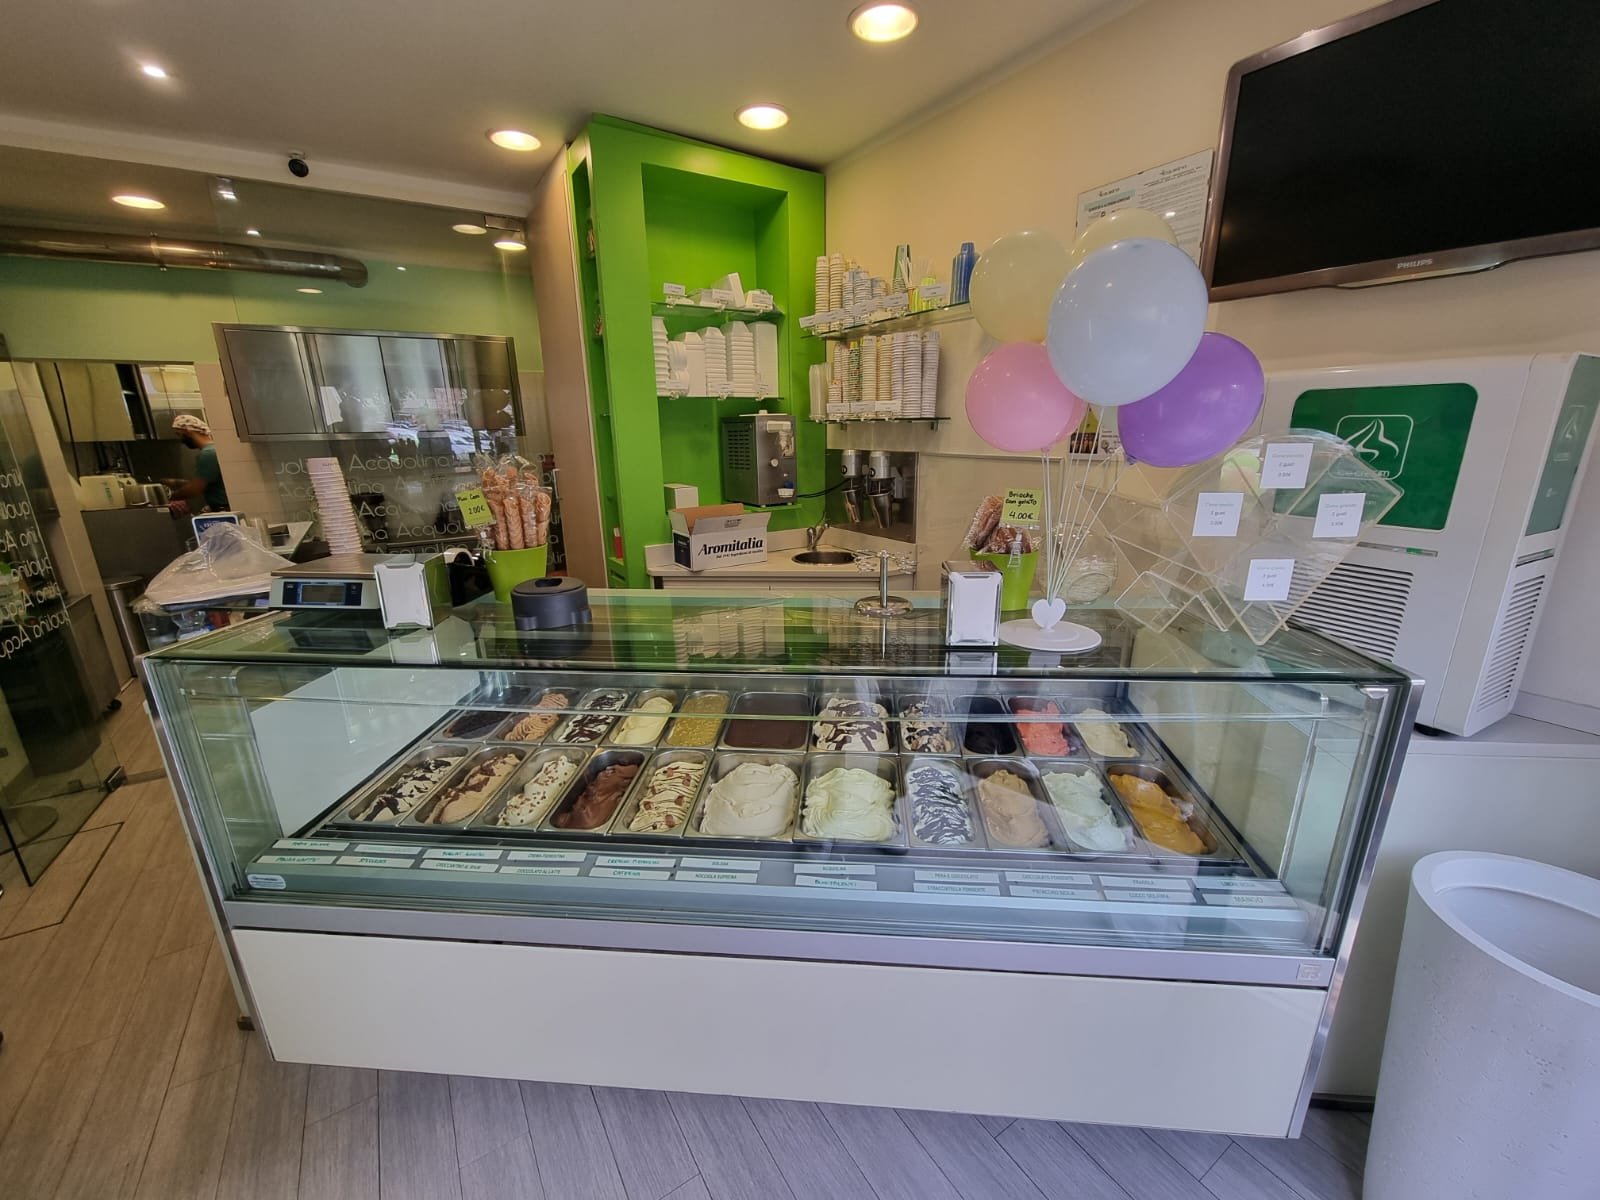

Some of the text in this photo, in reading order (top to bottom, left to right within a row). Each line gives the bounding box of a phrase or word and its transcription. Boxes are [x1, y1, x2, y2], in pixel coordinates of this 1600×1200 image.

[1396, 258, 1433, 269] PHILIPS
[349, 454, 450, 472] Acquolina
[1008, 491, 1034, 499] Brioche
[359, 501, 462, 518] Acquna
[698, 537, 764, 556] Aromitalia
